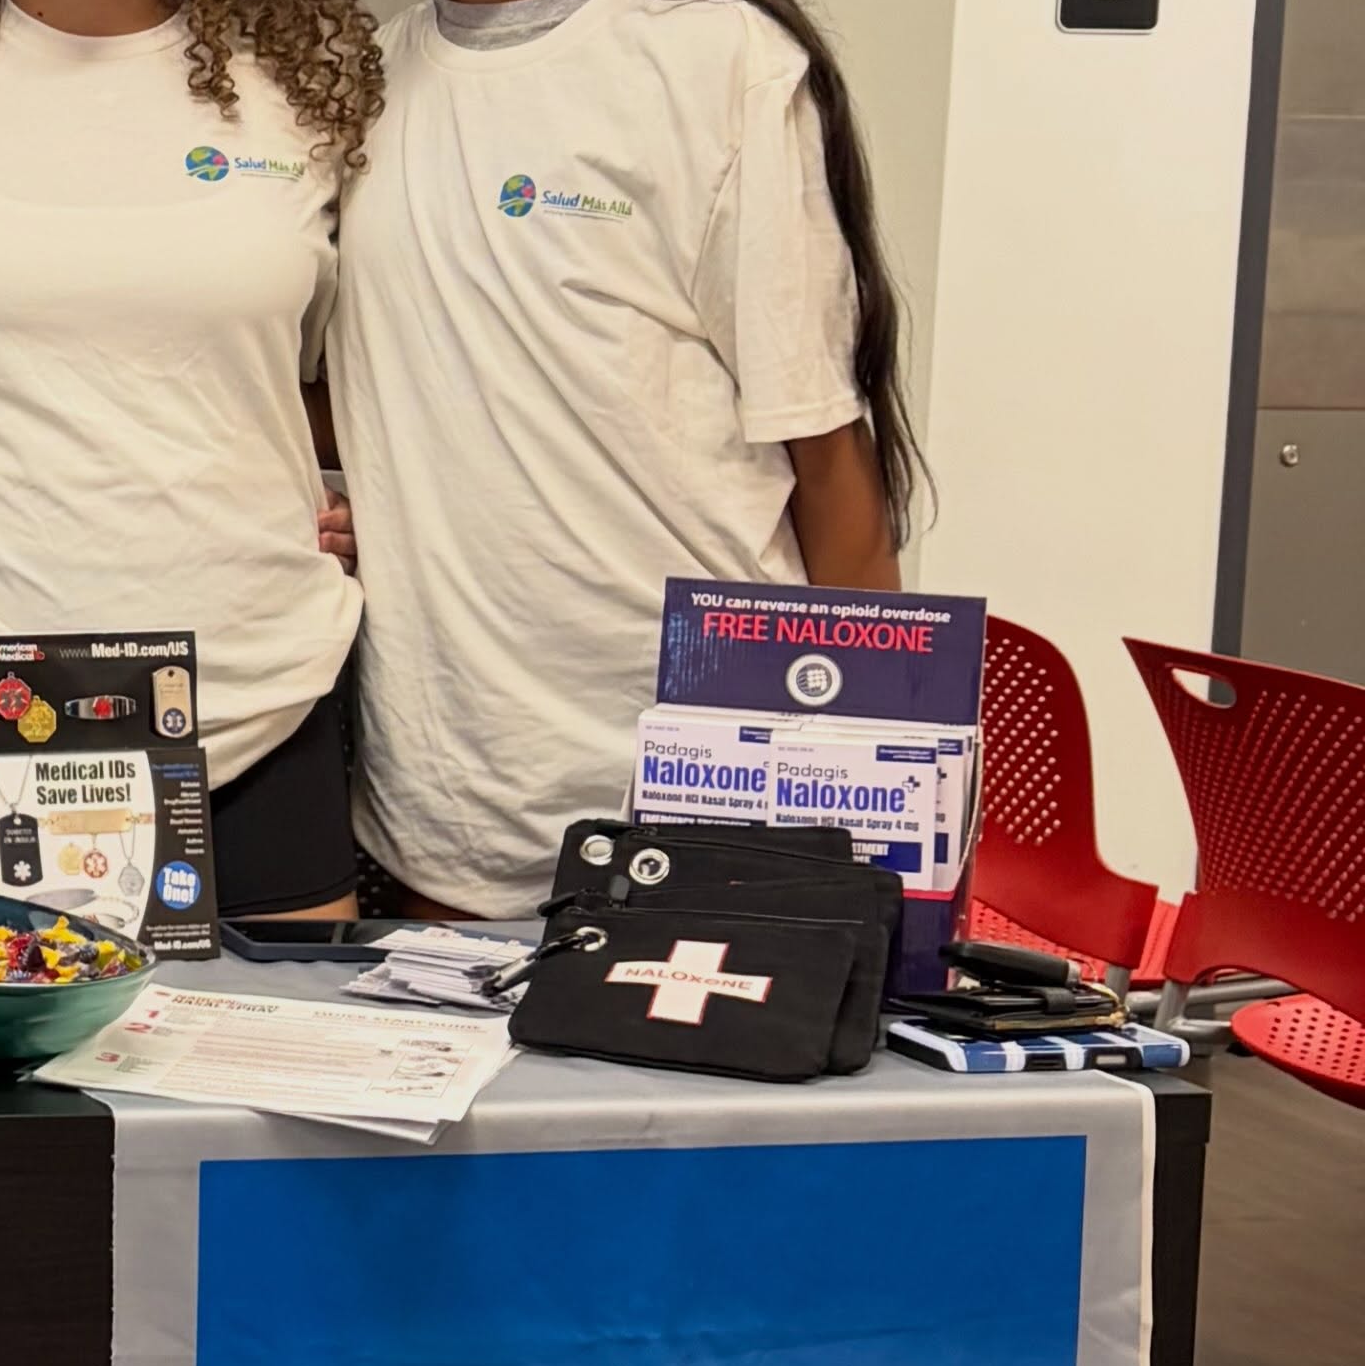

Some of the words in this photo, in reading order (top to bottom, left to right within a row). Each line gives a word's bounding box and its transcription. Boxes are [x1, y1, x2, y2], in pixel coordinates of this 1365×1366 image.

[235, 158, 266, 169] Salud
[541, 190, 580, 207] Salud
[692, 593, 723, 607] YOU
[726, 597, 751, 610] can
[754, 599, 806, 614] reverse
[810, 604, 829, 615] an
[833, 603, 880, 619] opioid
[882, 606, 951, 623] overdose
[703, 612, 769, 642] FREE
[776, 617, 933, 653] NALOXONE
[644, 740, 712, 759] Padagis
[35, 762, 103, 781] Medical
[109, 760, 136, 779] IDs
[643, 755, 766, 792] Naloxone
[778, 762, 848, 781] Padagis
[37, 785, 78, 805] Save
[83, 784, 132, 803] Lives!
[777, 777, 905, 813] Naloxone
[163, 867, 196, 886] Take
[163, 885, 195, 903] One!
[625, 968, 753, 990] NALOXONE
